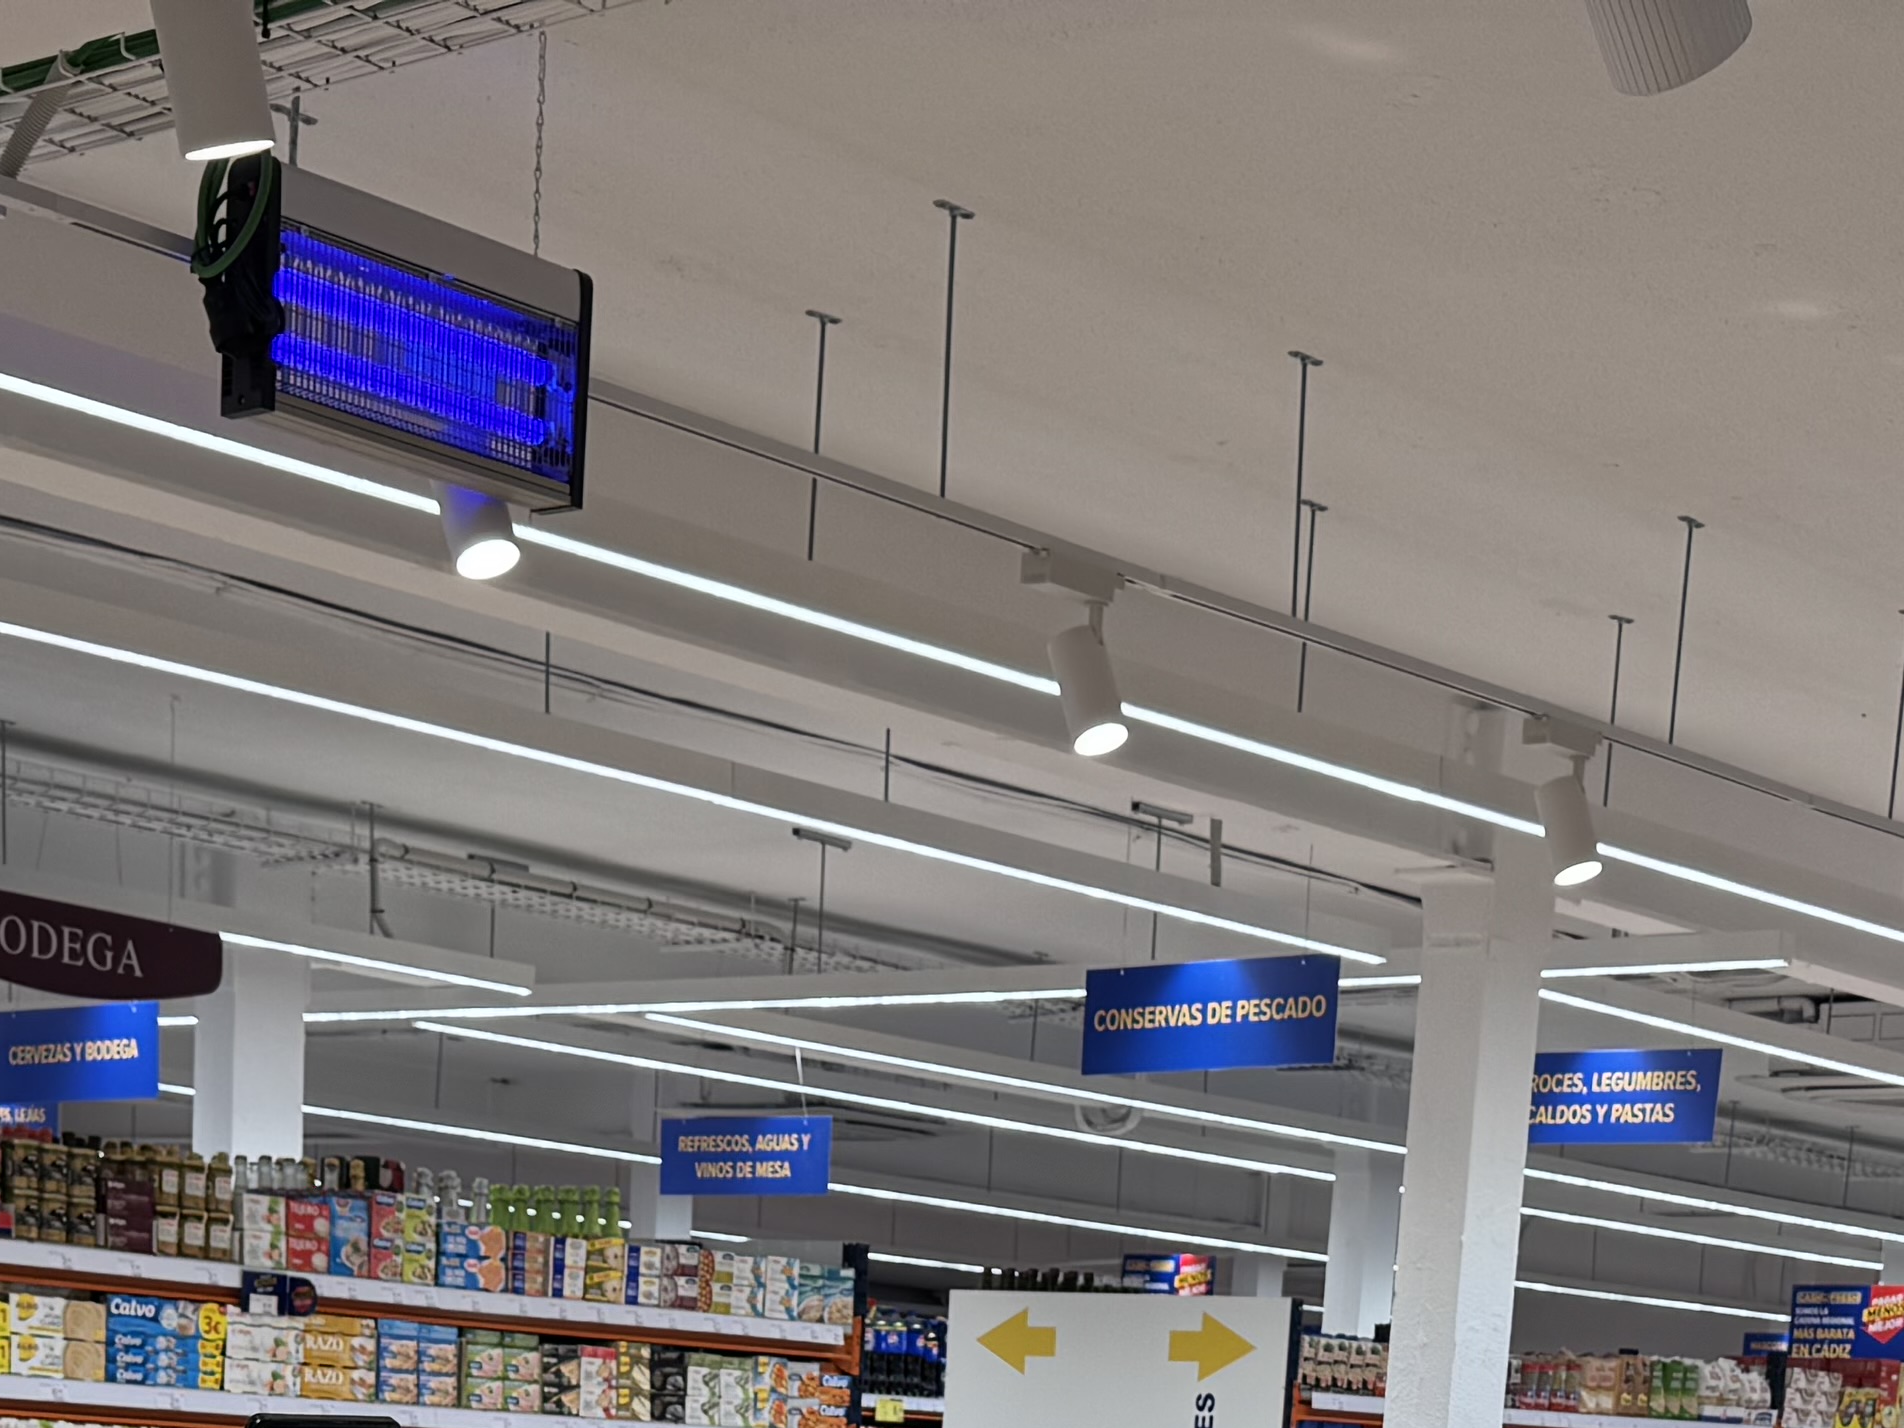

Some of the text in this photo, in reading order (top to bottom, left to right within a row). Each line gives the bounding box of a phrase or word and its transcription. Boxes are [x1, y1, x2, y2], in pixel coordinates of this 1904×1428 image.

[1094, 994, 1327, 1031] CONSERVAS DE PESCADO
[8, 1038, 138, 1066] CERVEZAS Y BODEGA
[1532, 1070, 1701, 1095] ROCES, LEGUMBRES,
[1529, 1103, 1675, 1125] CALDOS Y PASTAS
[678, 1134, 811, 1153] REFRESCOS, AGUAS Y
[695, 1161, 791, 1178] VINOS DE MESA
[110, 1299, 155, 1318] Calvo
[1792, 1341, 1852, 1358] EN CÁDIZ
